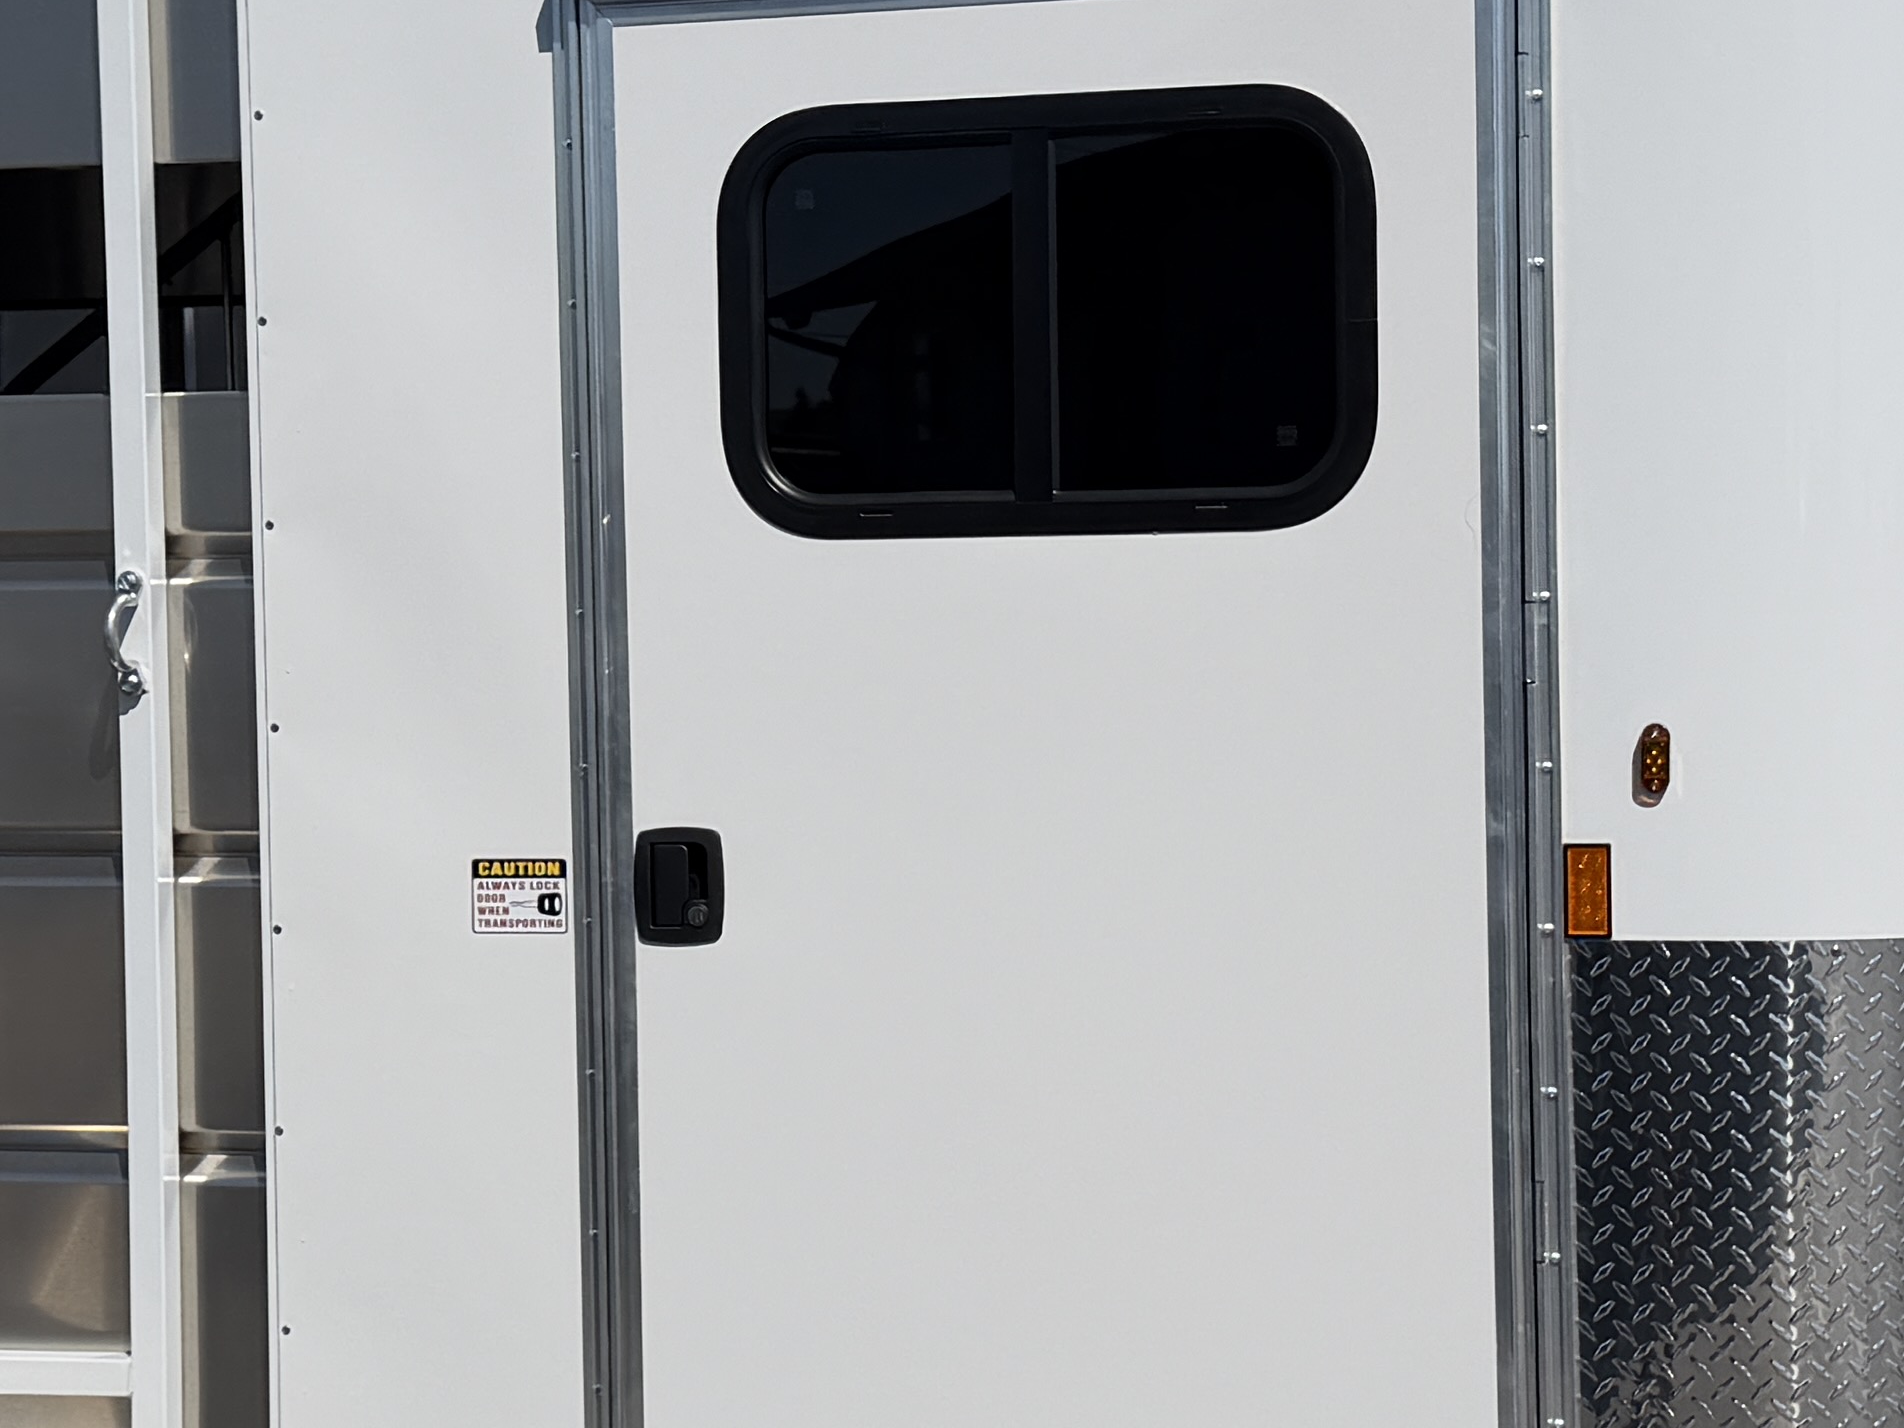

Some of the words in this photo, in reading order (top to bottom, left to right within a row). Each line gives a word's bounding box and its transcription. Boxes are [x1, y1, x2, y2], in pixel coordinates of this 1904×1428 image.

[478, 861, 561, 876] CAUTION
[477, 881, 526, 890] ALWAYS
[529, 881, 561, 891] LOCK
[476, 893, 506, 903] DOOR
[477, 906, 510, 916] WHEN
[477, 918, 563, 928] TRANSPORTING
